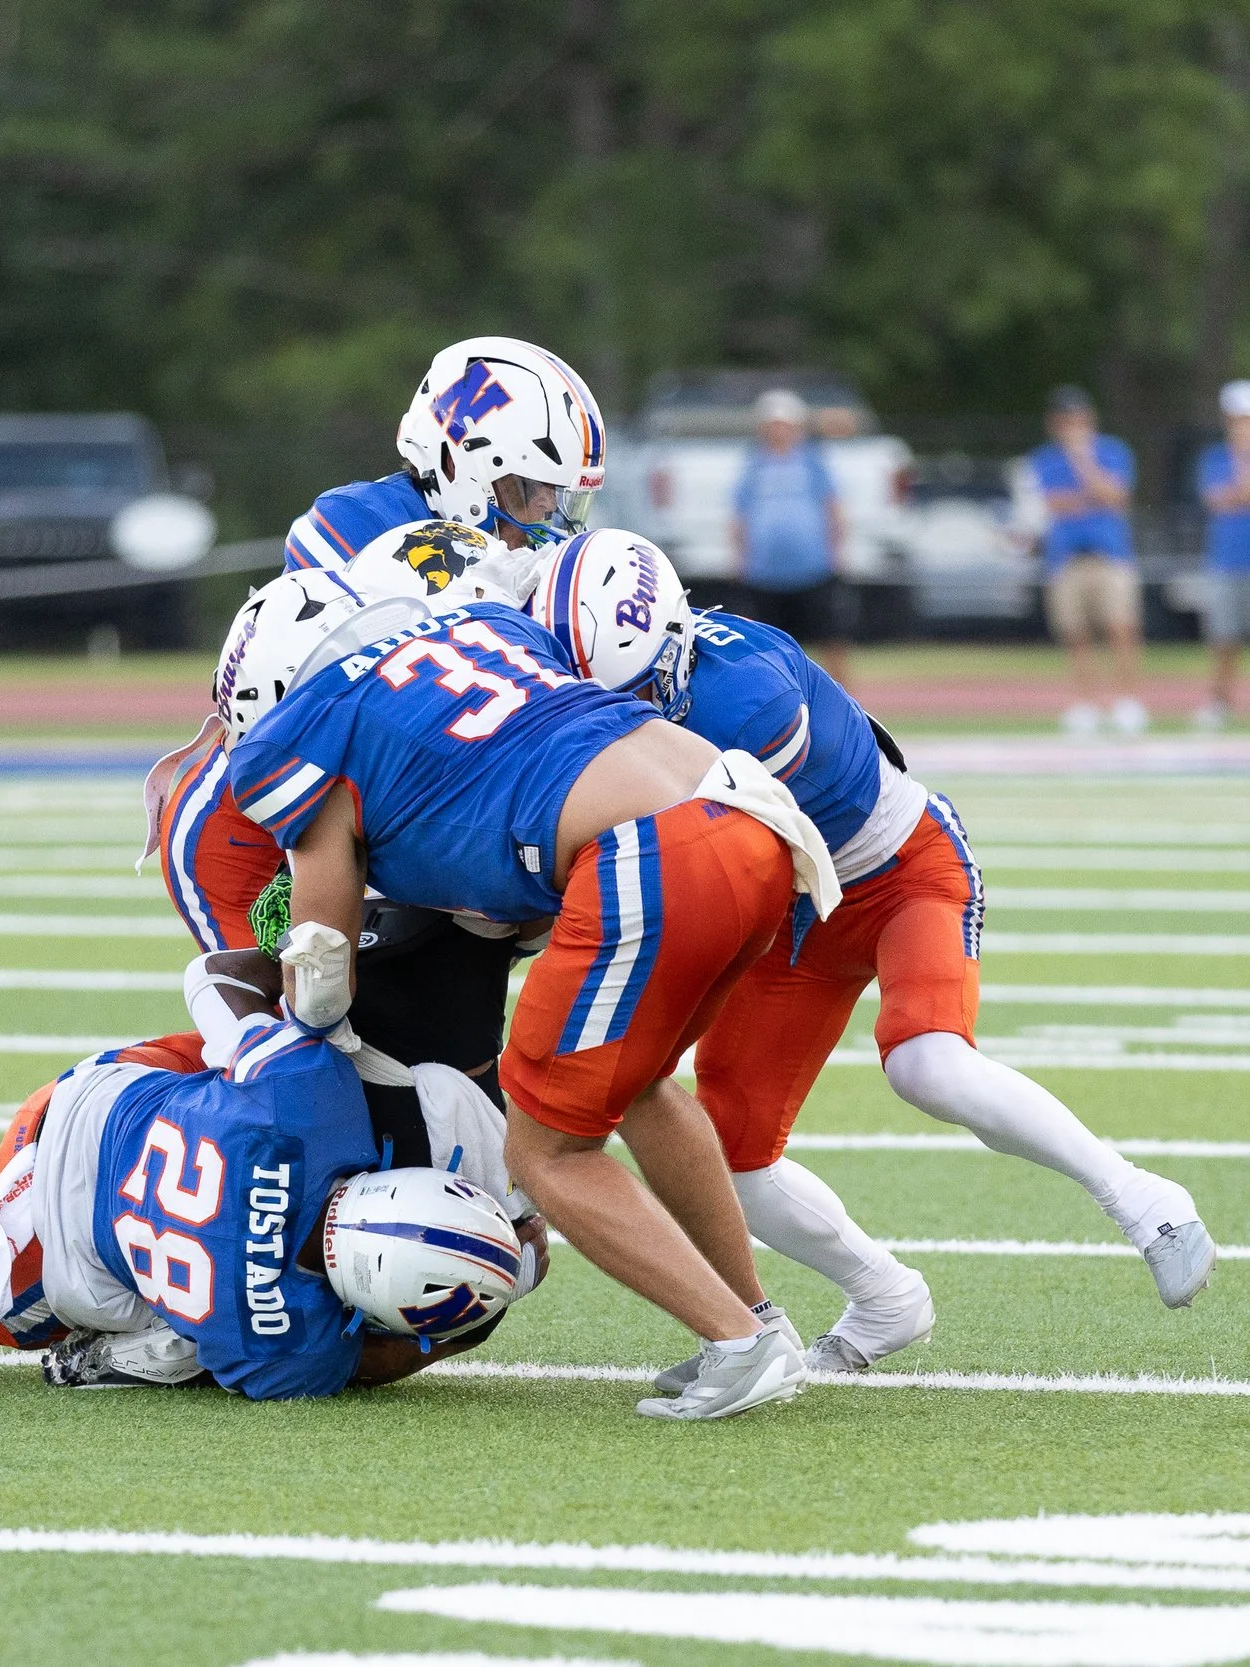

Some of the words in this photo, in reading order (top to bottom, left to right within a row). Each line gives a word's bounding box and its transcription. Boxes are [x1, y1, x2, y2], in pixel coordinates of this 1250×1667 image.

[429, 359, 514, 446] N
[377, 618, 582, 742] 31
[113, 1115, 227, 1325] 28
[246, 1163, 291, 1335] TOSTADO
